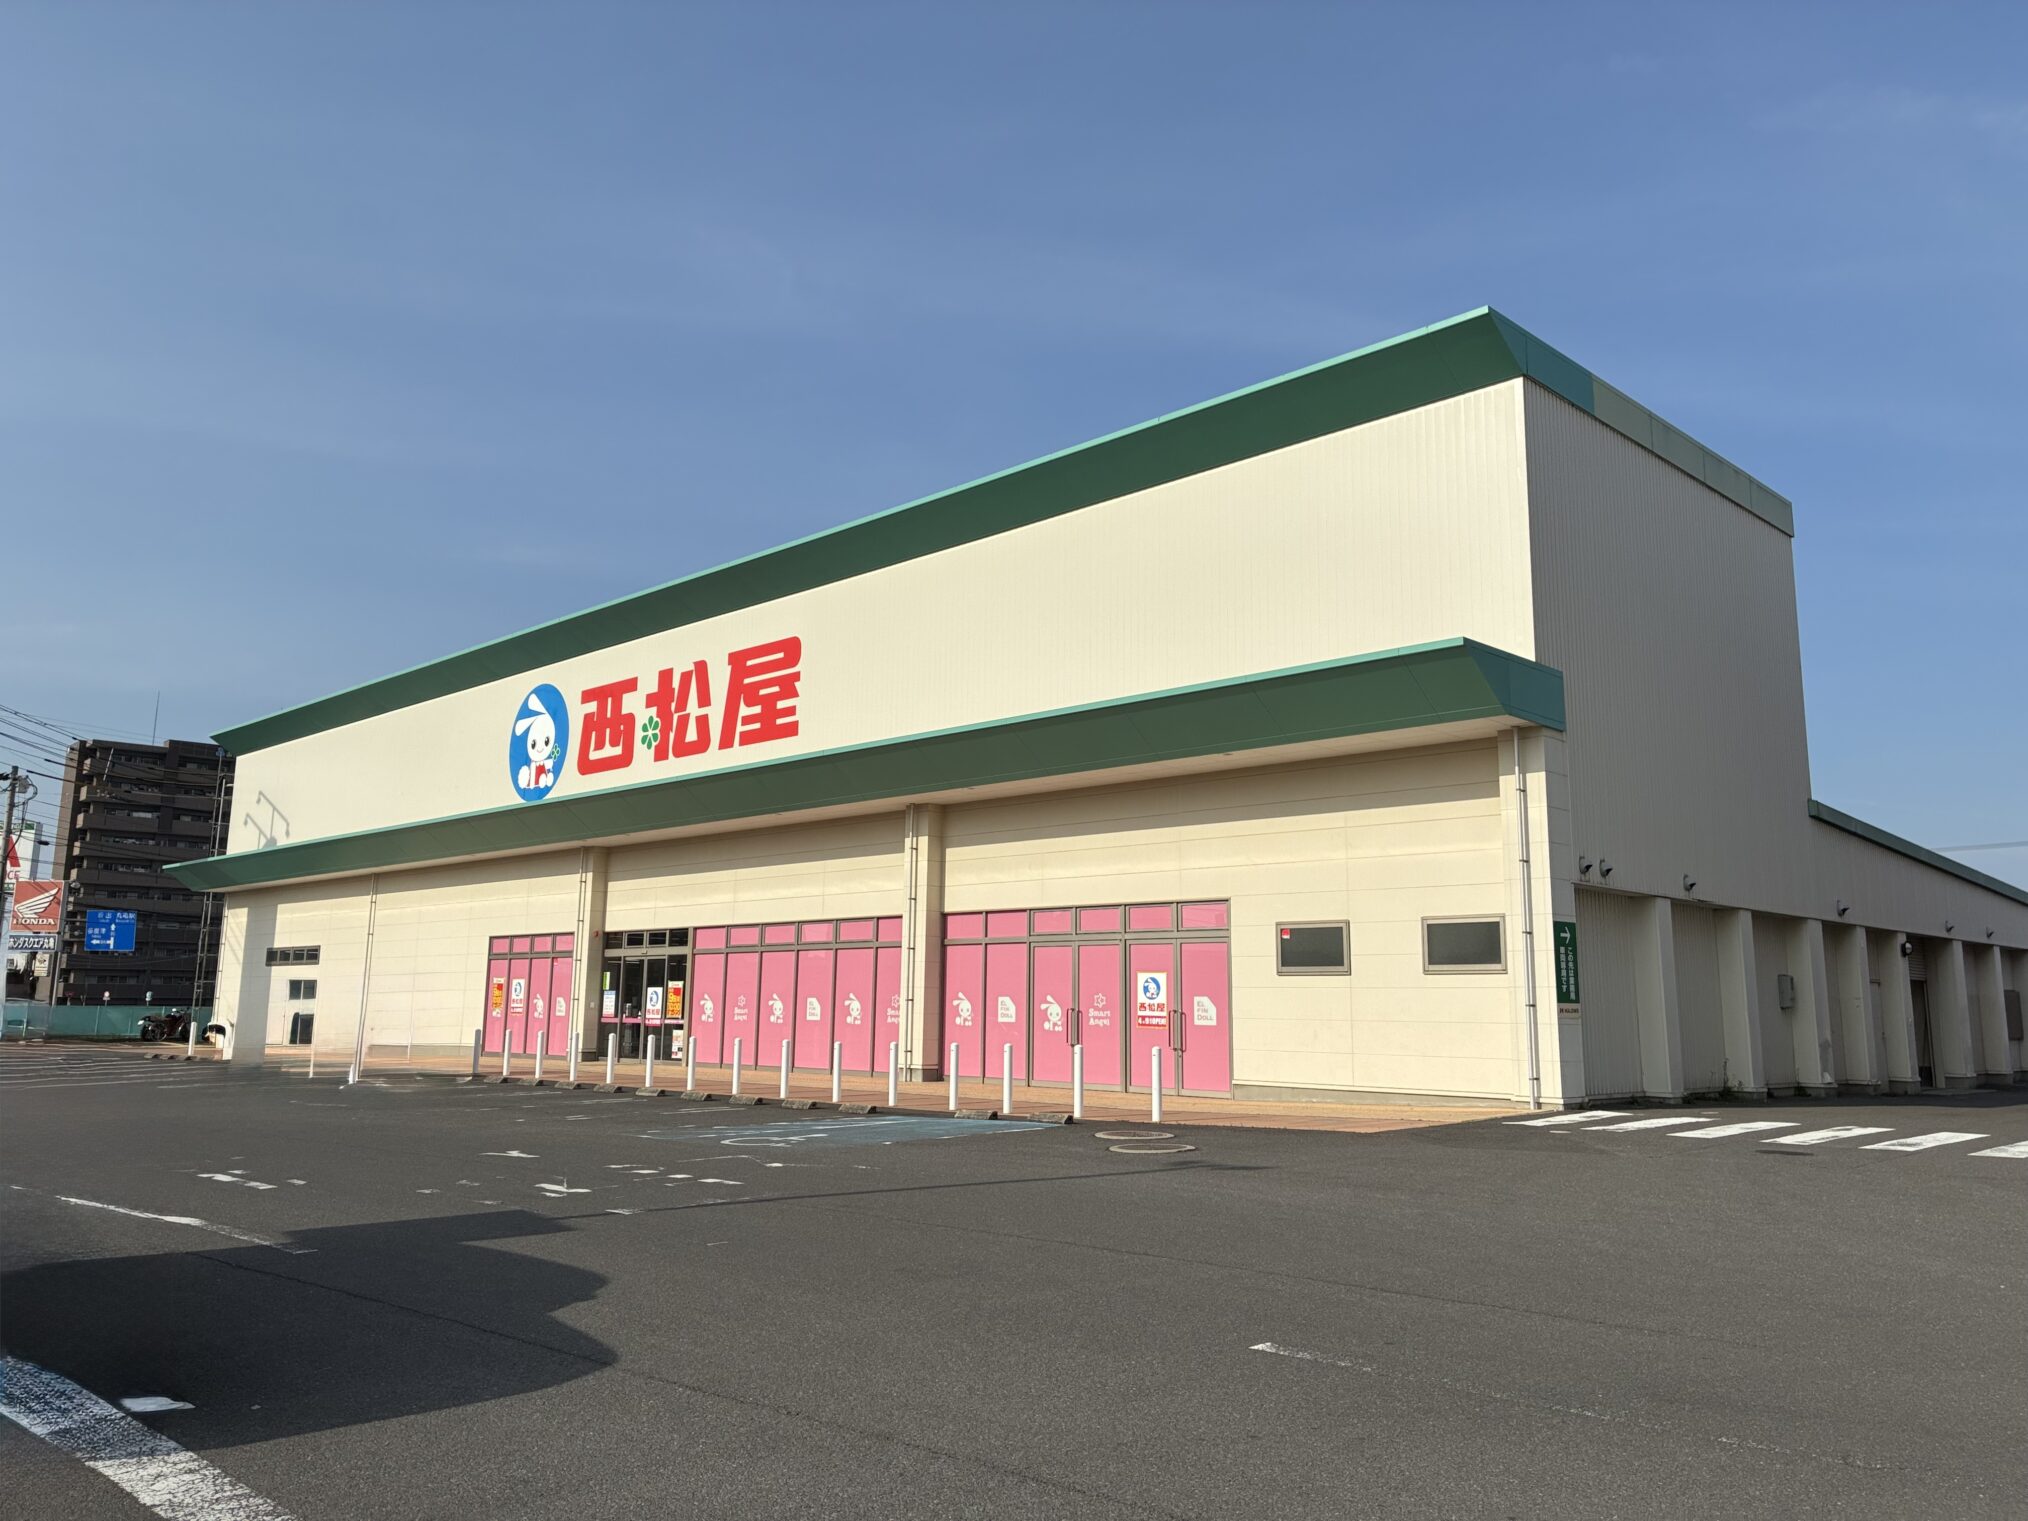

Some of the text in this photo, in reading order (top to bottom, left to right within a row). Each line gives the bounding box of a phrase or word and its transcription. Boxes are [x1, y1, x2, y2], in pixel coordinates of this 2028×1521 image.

[577, 636, 801, 775] 西松屋
[13, 918, 56, 926] HONDA
[1138, 1002, 1166, 1012] 西松屋
[1088, 1008, 1111, 1016] Smart
[1088, 1017, 1110, 1026] Angel
